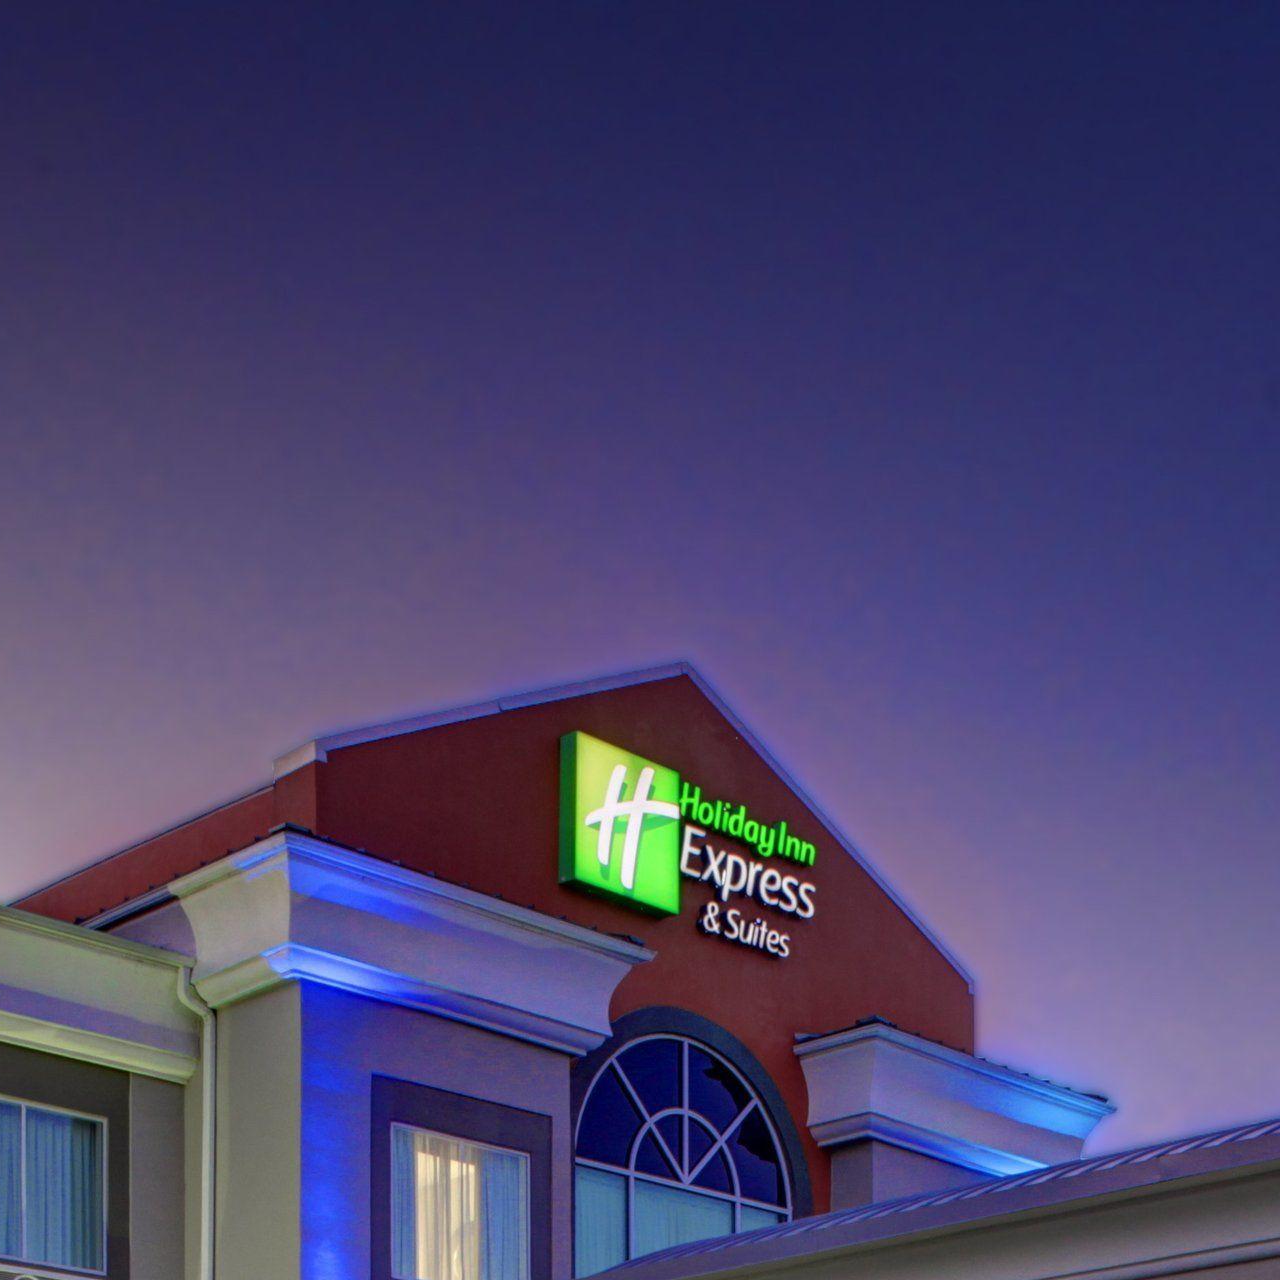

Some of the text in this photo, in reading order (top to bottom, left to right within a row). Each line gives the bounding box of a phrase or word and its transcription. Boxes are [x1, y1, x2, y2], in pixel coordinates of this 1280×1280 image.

[680, 782, 816, 866] Holiday Inn
[680, 824, 816, 919] Express
[703, 901, 790, 957] & Suites
